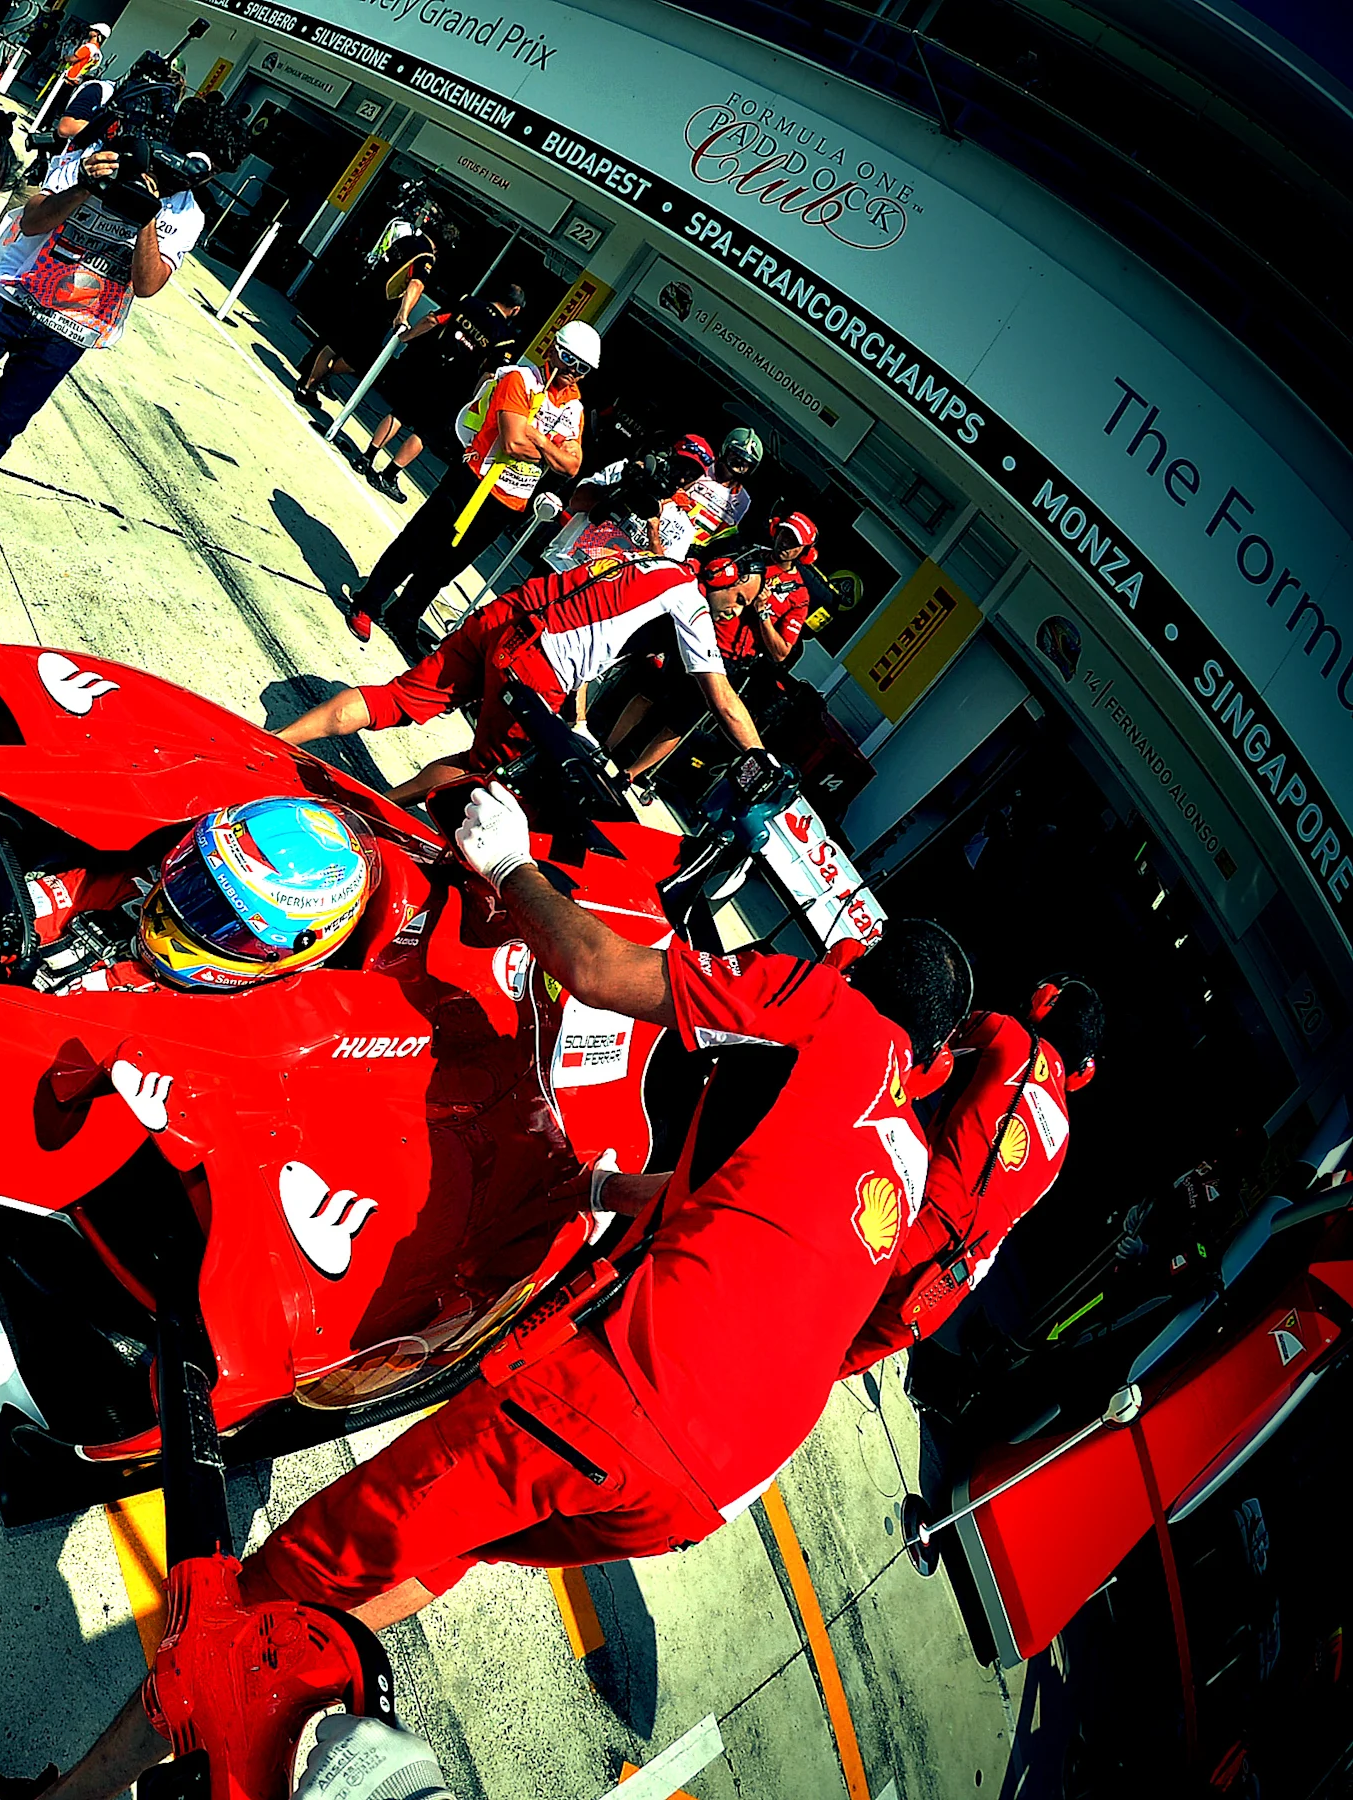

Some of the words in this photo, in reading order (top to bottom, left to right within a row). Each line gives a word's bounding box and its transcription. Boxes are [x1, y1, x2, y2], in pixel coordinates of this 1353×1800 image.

[418, 0, 506, 47] Grand
[497, 26, 558, 72] Prix
[359, 103, 377, 117] 23
[456, 155, 481, 173] LOTUS
[488, 171, 512, 191] TEAM
[684, 104, 908, 252] Club
[706, 109, 904, 235] PADDOCK
[724, 90, 846, 168] FORMULA
[855, 160, 916, 207] ONE
[569, 223, 595, 246] 22
[454, 312, 490, 349] LOTUS
[694, 308, 709, 324] 13
[711, 321, 755, 360] PASTOR
[751, 352, 822, 413] MALDONADO
[243, 2, 298, 32] SPIELBERG
[311, 26, 393, 71] SILVERSTONE
[409, 65, 517, 131] HOCKENHEIM
[540, 130, 653, 202] BUDAPEST
[684, 211, 986, 444] SPA-FRANCORCHAMPS
[1030, 478, 1145, 610] MONZA
[1193, 659, 1353, 902] SINGAPORE
[1102, 375, 1202, 508] The
[867, 584, 959, 694] PIRELLI
[818, 773, 844, 792] 14
[1081, 668, 1102, 695] 14
[1103, 695, 1175, 786] FERNANDO
[1166, 784, 1221, 856] ALONSO
[217, 872, 250, 914] HUBLOT
[331, 1035, 431, 1059] HUBLOT
[1292, 987, 1326, 1036] 20
